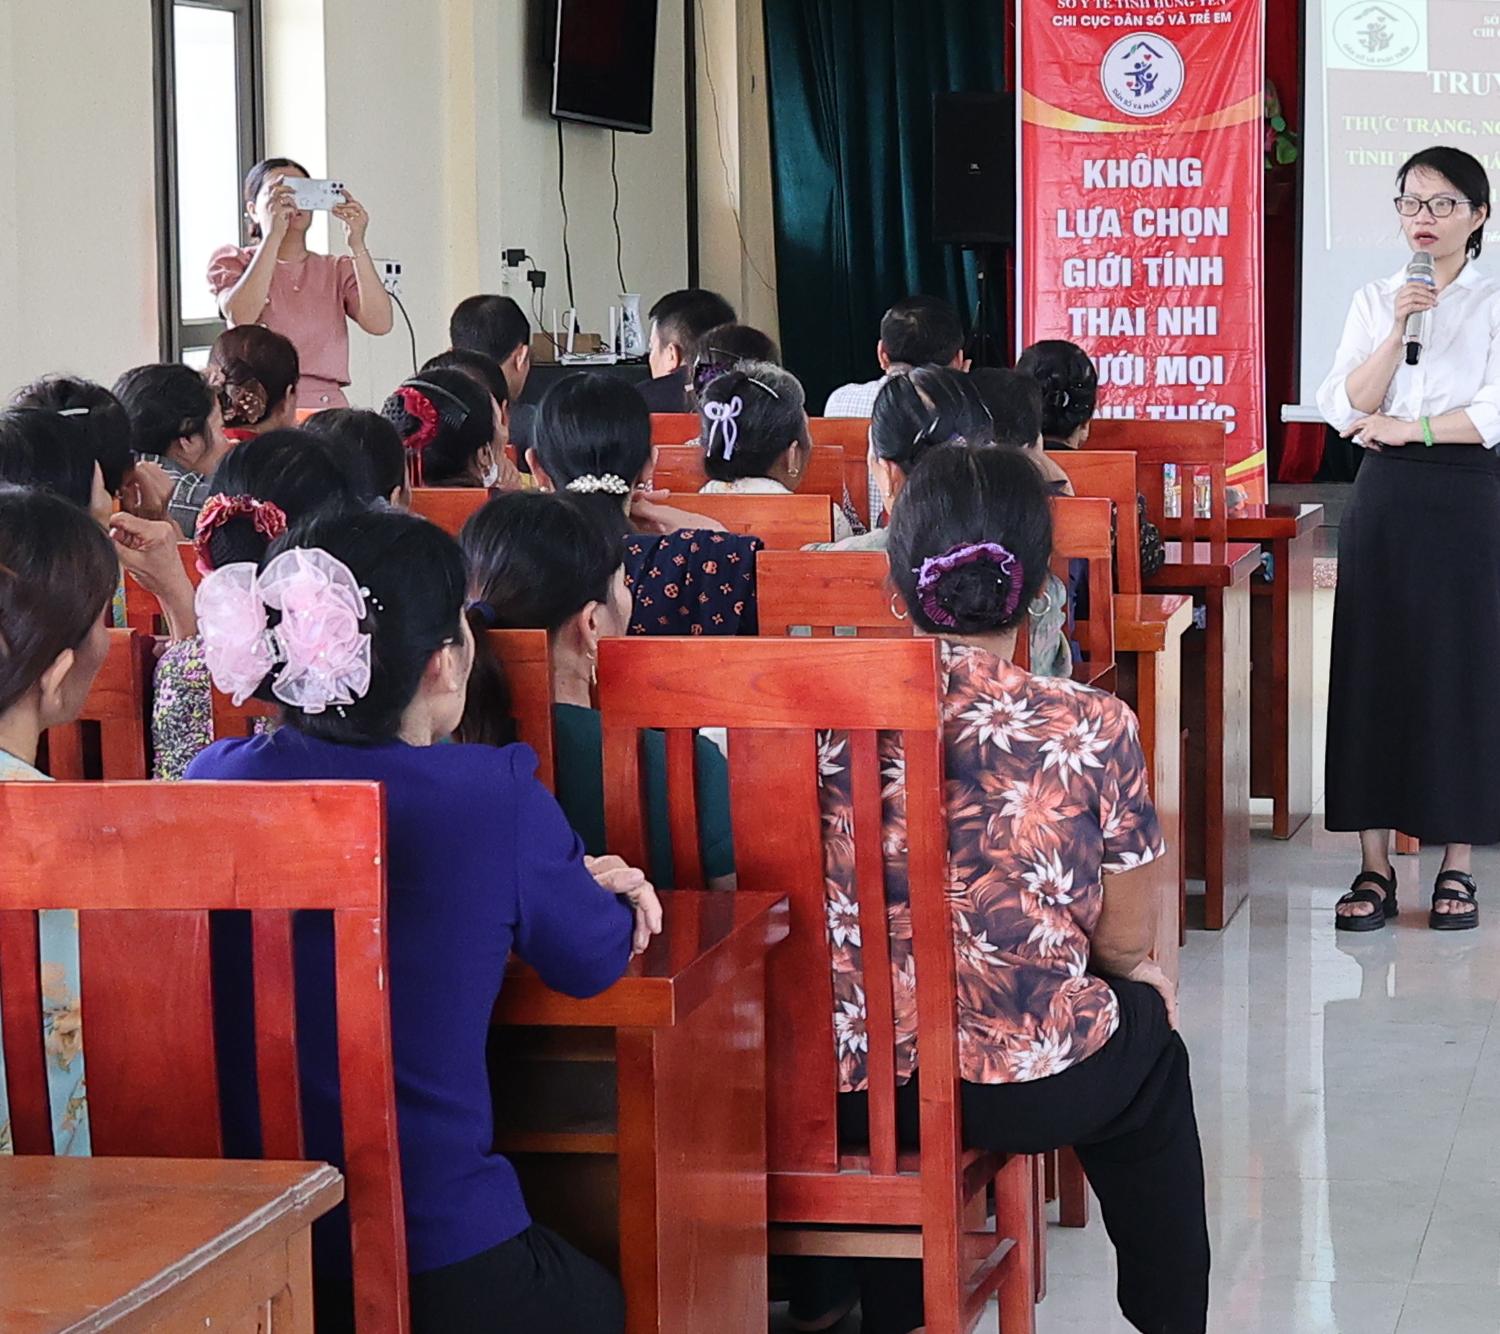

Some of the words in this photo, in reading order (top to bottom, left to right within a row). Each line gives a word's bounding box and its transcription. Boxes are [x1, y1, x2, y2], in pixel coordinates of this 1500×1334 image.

[1052, 15, 1077, 26] CHI
[1080, 15, 1110, 29] CỤC
[1114, 12, 1143, 26] DÂN
[1146, 11, 1165, 26] SỐ
[1168, 11, 1186, 25] VÀ
[1189, 9, 1210, 24] TRẺ
[1214, 11, 1232, 23] EM
[1083, 153, 1203, 189] KHÔNG
[1056, 207, 1122, 247] LỰA
[1132, 207, 1229, 245] CHỌN
[1063, 252, 1132, 288] GIỚI
[1143, 251, 1224, 287] TÍNH
[1068, 306, 1146, 336] THAI
[1157, 306, 1217, 336] NHI
[1092, 350, 1145, 386] ƯỚI
[1155, 355, 1224, 392] MỌI
